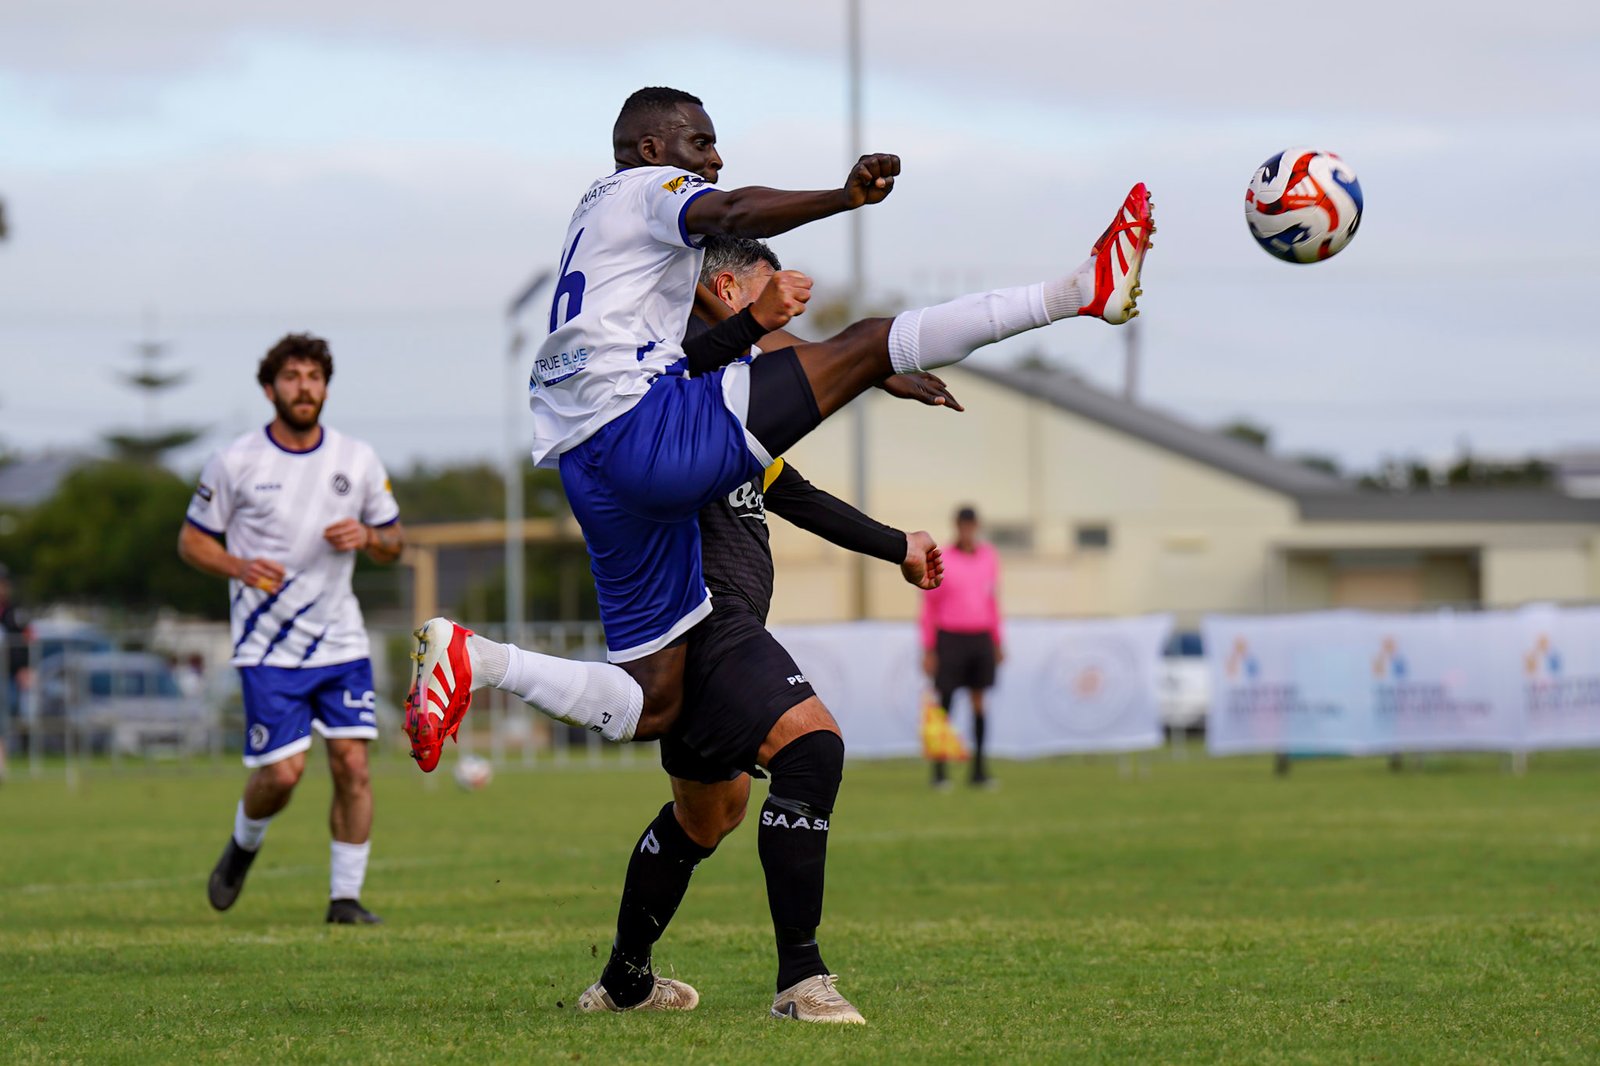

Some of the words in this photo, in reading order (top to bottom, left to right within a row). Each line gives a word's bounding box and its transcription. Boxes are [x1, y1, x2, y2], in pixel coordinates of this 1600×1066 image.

[535, 355, 561, 373] TRUE
[561, 348, 588, 366] BLUE
[786, 673, 806, 684] PE
